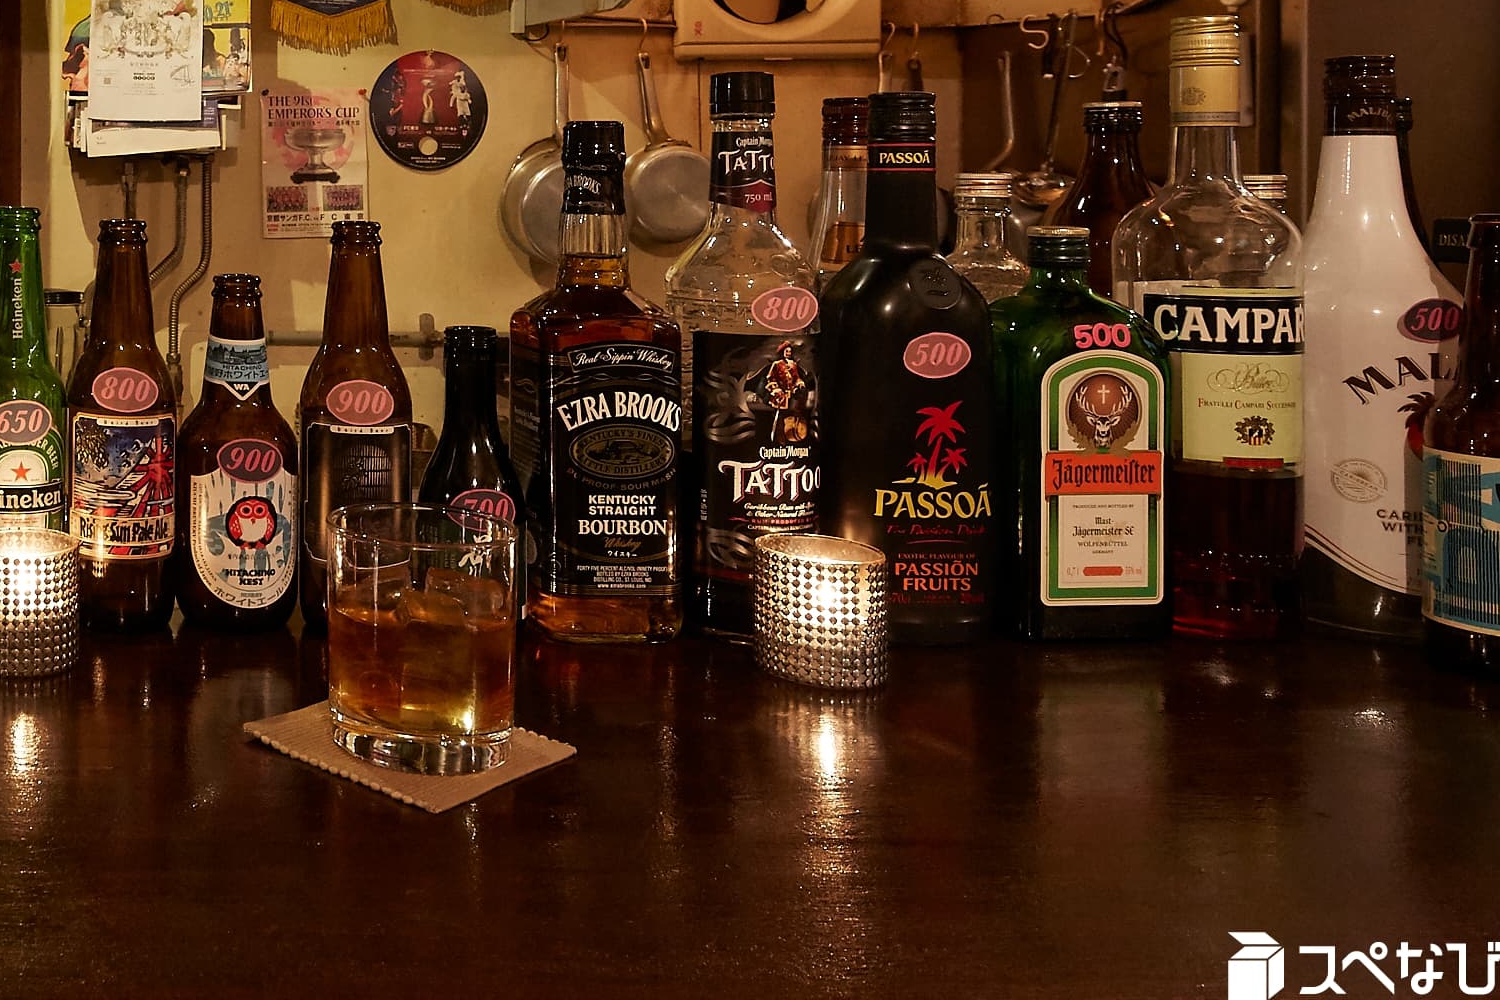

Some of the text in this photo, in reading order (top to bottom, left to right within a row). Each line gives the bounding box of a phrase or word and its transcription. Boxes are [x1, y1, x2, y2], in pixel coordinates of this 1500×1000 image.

[268, 96, 291, 107] THE
[268, 107, 360, 120] EMPEROR'S CUP
[735, 137, 756, 148] Captain
[744, 193, 761, 204] 750
[12, 277, 24, 340] Heineken
[763, 296, 811, 320] 800
[1410, 306, 1459, 332] 500
[1073, 322, 1132, 349] 500
[572, 350, 599, 368] Real
[911, 342, 962, 366] 500
[100, 376, 150, 402] 800
[234, 383, 250, 391] WA
[335, 389, 387, 414] 900
[556, 391, 682, 432] EZRA BROOKS
[47, 444, 59, 470] BEER
[225, 447, 276, 473] 900
[759, 445, 809, 459] Captain Morgan
[587, 494, 656, 506] KENTUCKY
[588, 505, 656, 516] STRAIGHT
[577, 519, 668, 536] BOURBON
[1072, 525, 1124, 538] Jägermeister
[224, 568, 276, 577] HITACHINO
[239, 577, 264, 586] NEST
[902, 577, 972, 592] FRUITS
